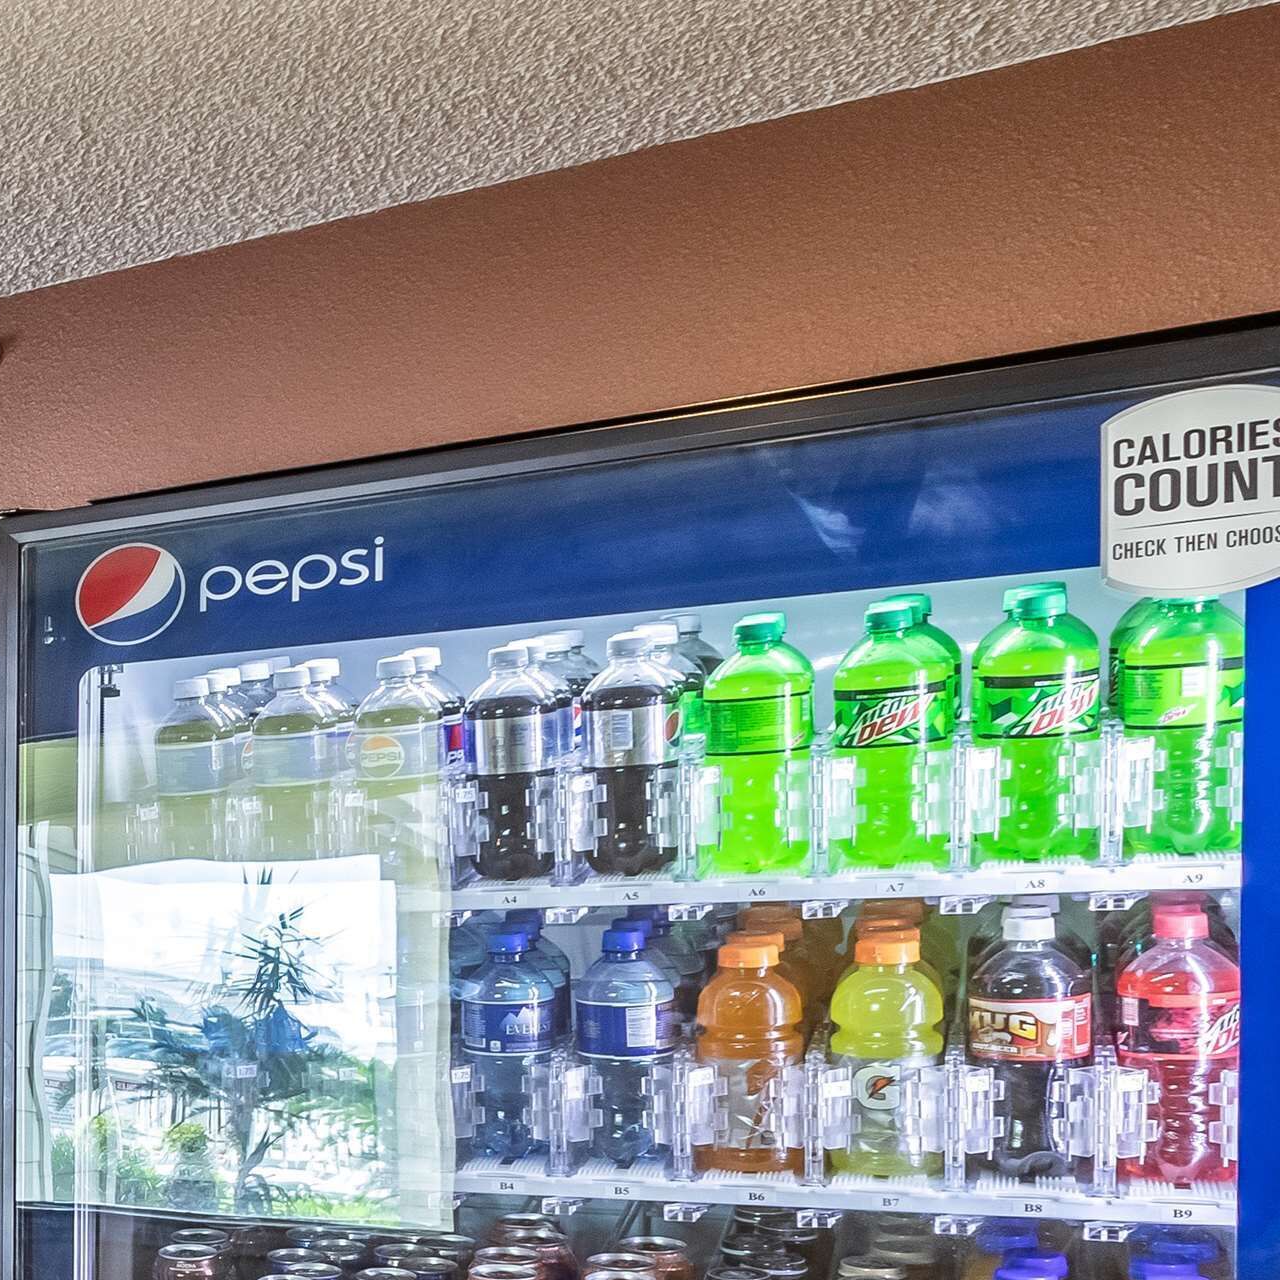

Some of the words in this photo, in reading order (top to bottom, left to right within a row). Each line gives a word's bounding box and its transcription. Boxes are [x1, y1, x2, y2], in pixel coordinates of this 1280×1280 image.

[1114, 454, 1280, 516] COUNT
[1112, 538, 1167, 560] CHECK
[1174, 532, 1218, 553] THEN
[199, 536, 384, 612] pepsi
[360, 751, 402, 763] PEPSI
[1182, 873, 1204, 884] A9
[886, 883, 904, 893] A7
[1025, 879, 1045, 889] A8
[622, 891, 639, 901] A5
[748, 888, 766, 897] A6
[852, 1065, 902, 1110] G
[499, 1181, 515, 1191] B4
[614, 1186, 630, 1196] B5
[748, 1192, 765, 1201] B6
[1024, 1203, 1043, 1213] B8
[1172, 1209, 1193, 1219] B9
